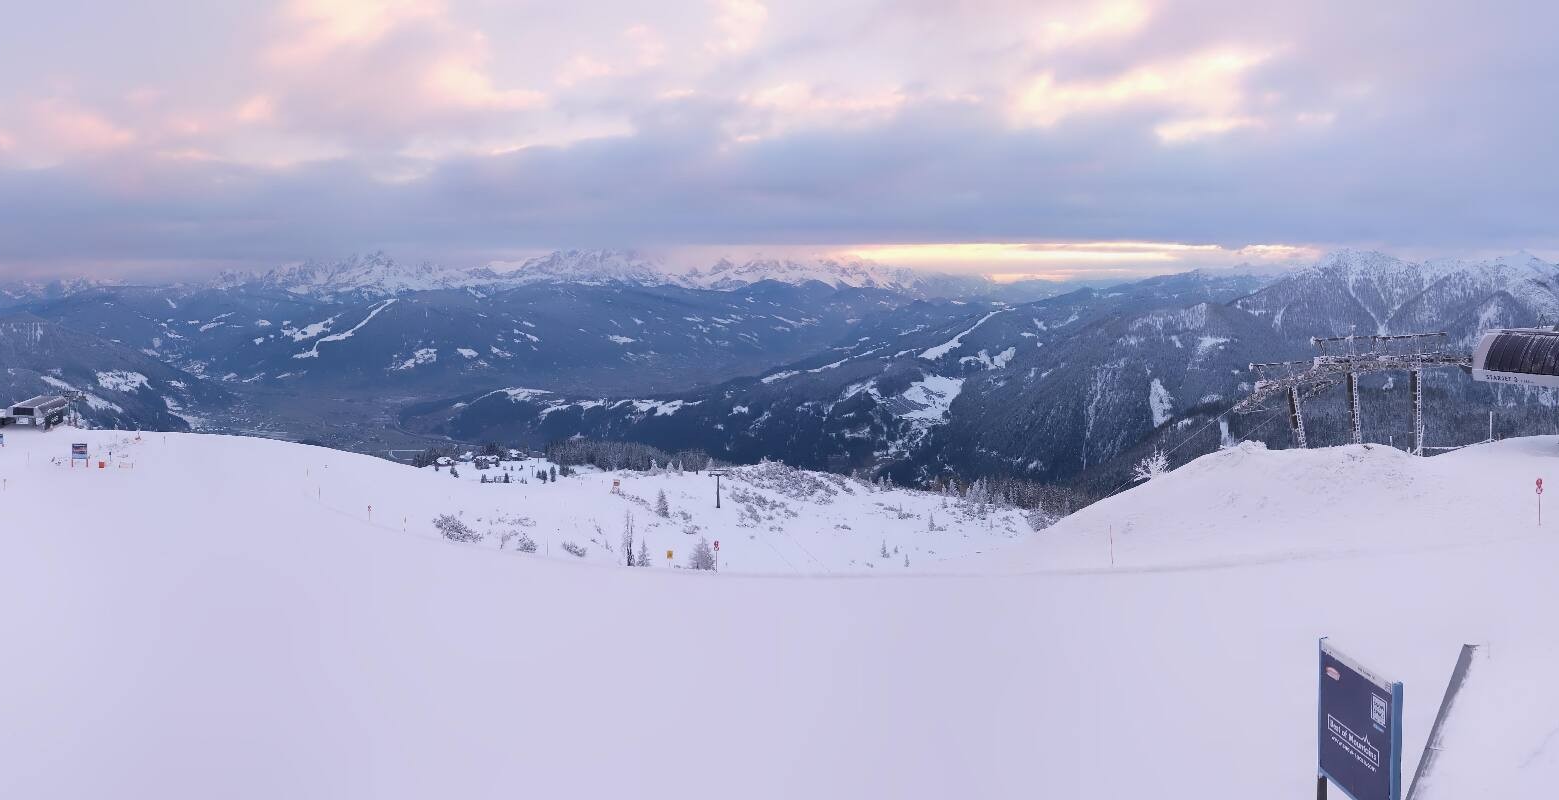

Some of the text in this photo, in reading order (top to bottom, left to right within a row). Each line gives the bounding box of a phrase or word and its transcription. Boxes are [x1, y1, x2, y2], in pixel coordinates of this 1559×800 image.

[1330, 719, 1377, 761] Best of Mountains
